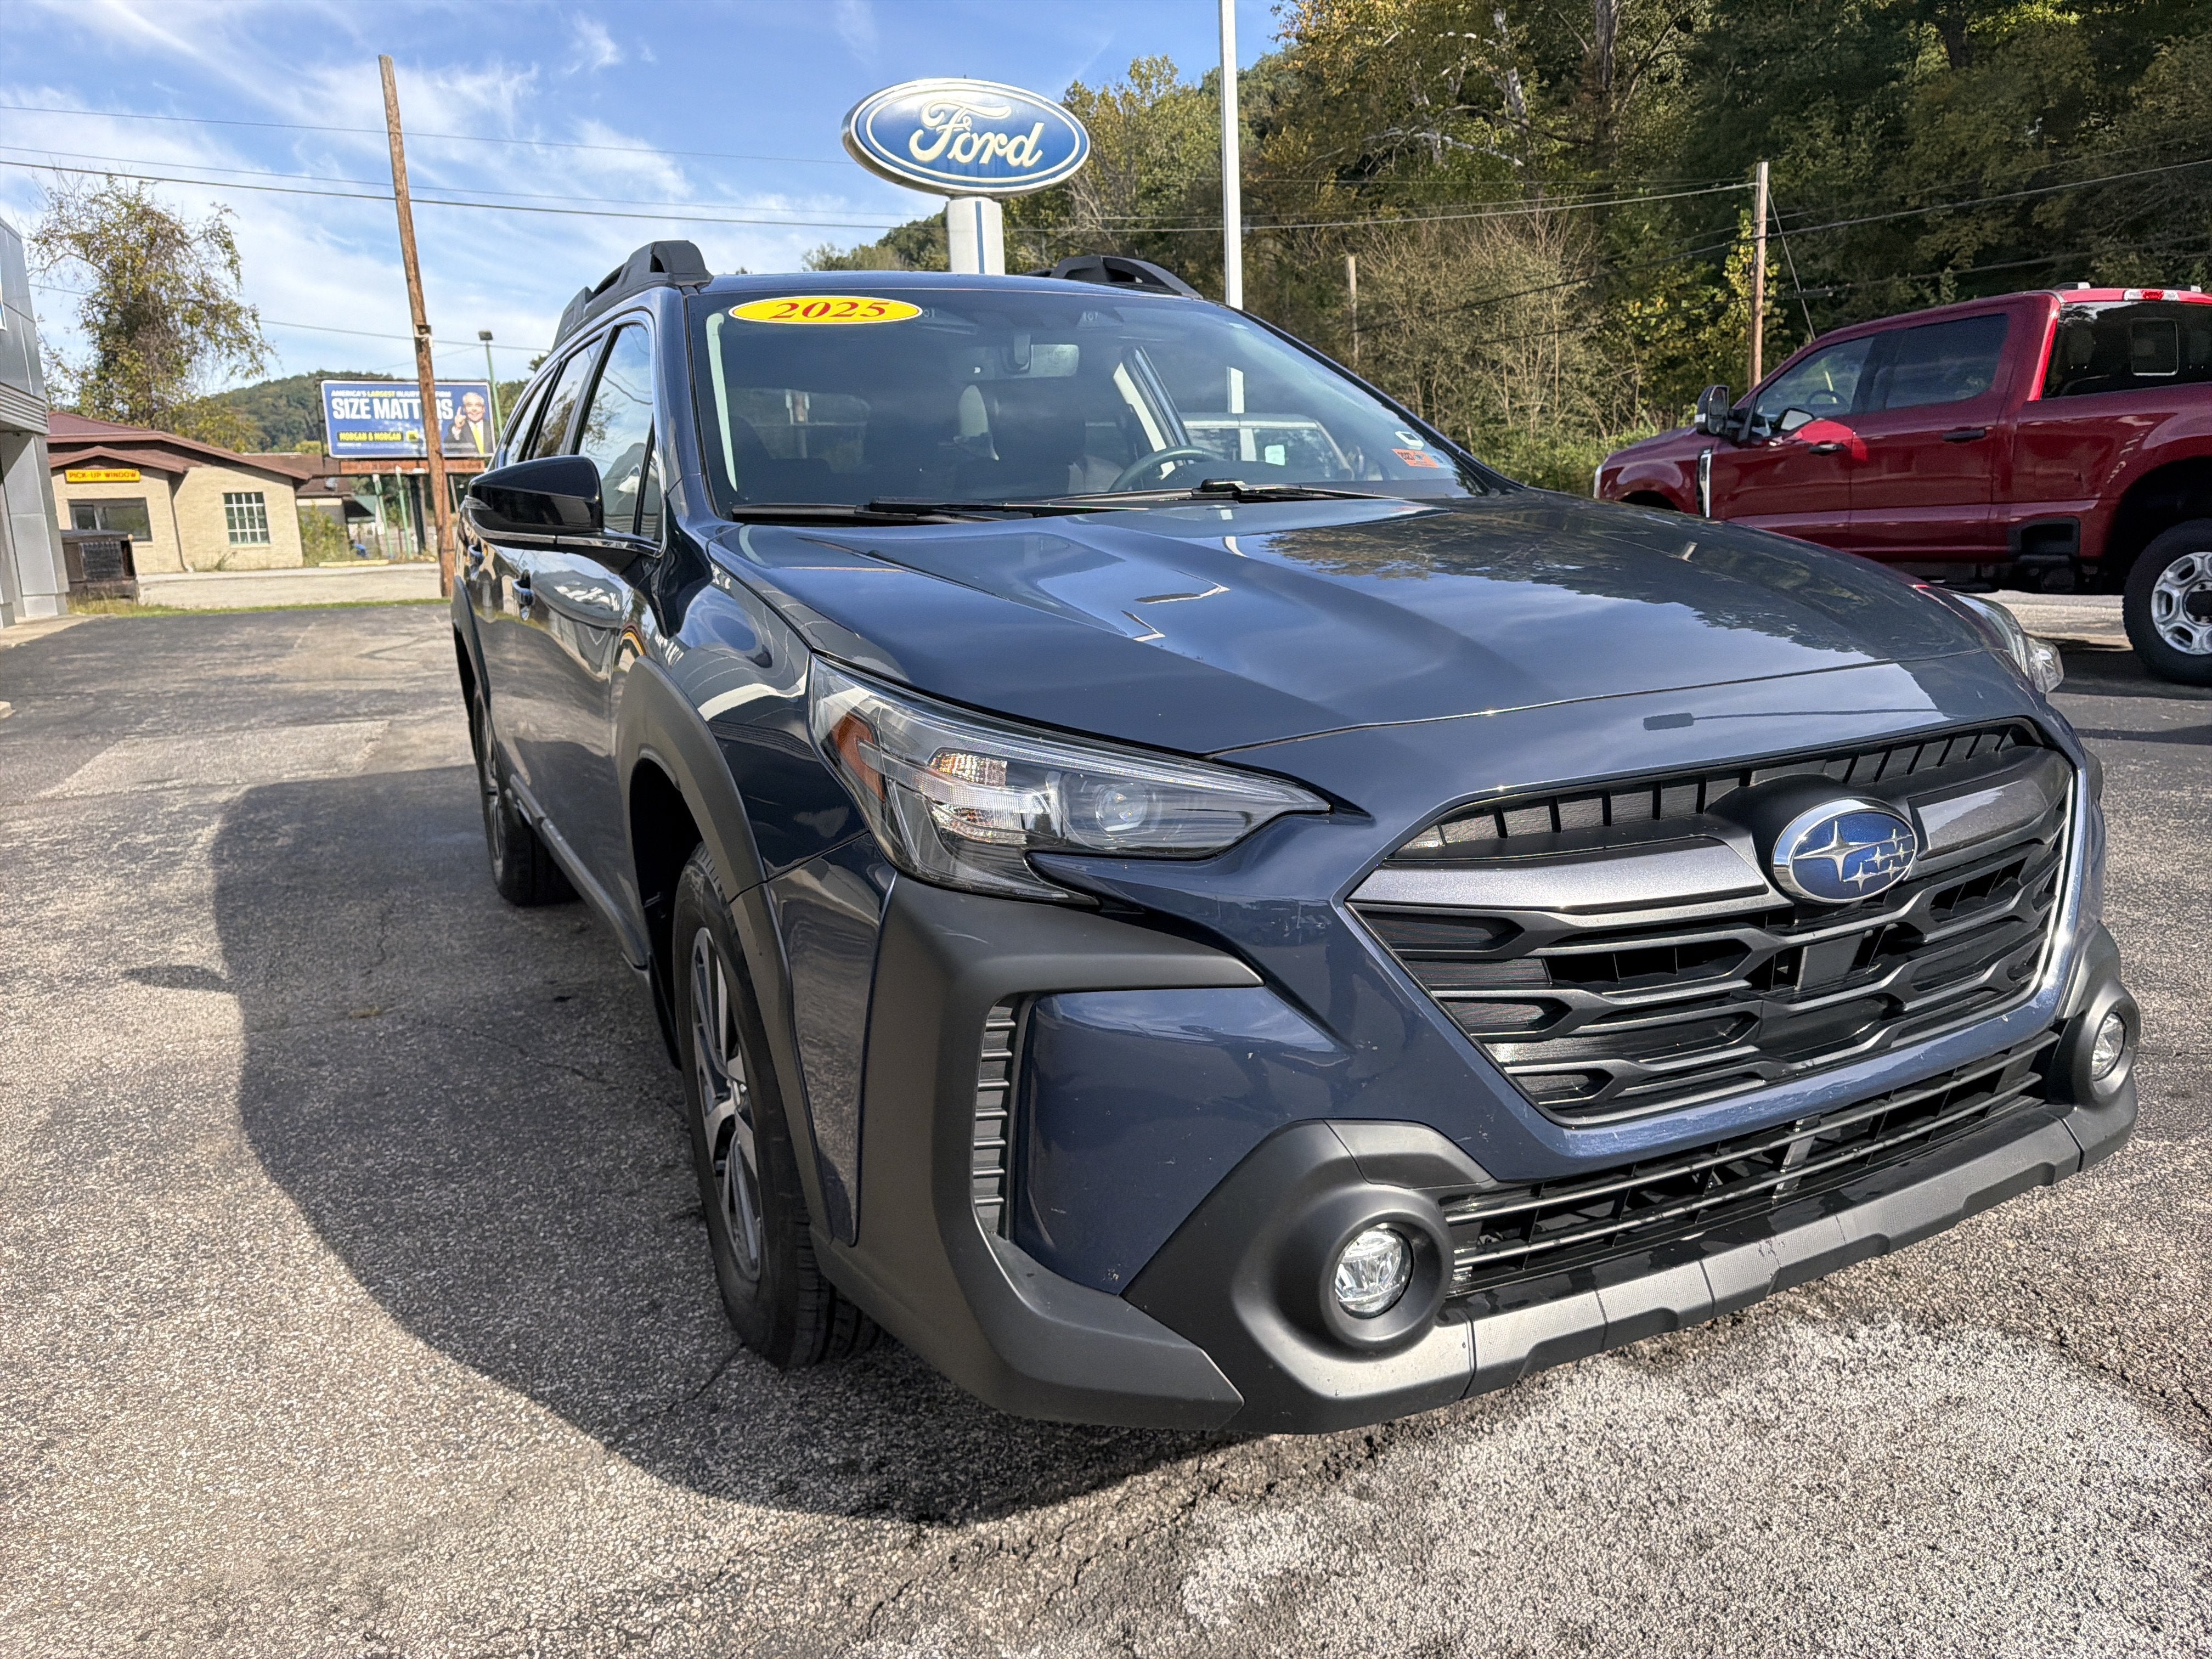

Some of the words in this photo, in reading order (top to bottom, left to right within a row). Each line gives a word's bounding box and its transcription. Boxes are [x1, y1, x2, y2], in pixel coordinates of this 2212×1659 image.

[909, 99, 1045, 168] Ford
[768, 302, 890, 319] 2025
[331, 398, 371, 419] SIZE
[373, 398, 454, 420] MATTS
[339, 432, 367, 441] MORGAN
[368, 432, 374, 441] &
[374, 432, 402, 441] MORGAN
